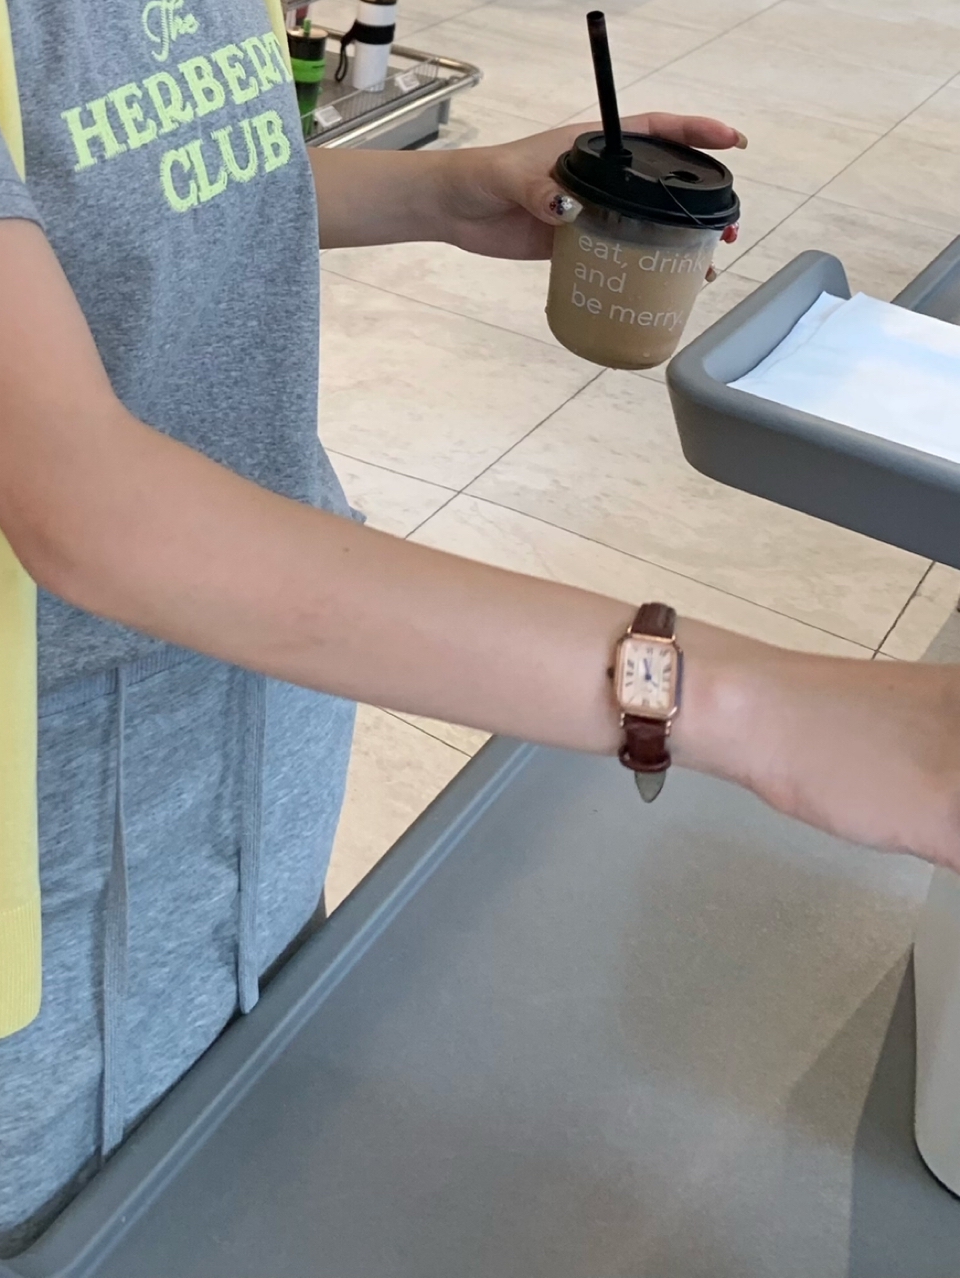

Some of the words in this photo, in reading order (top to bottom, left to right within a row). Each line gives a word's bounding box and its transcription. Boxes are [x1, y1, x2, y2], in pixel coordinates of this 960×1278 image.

[159, 109, 291, 212] CLUB
[577, 234, 629, 270] eat,
[637, 242, 704, 274] drink
[574, 261, 627, 294] and
[570, 282, 603, 315] be
